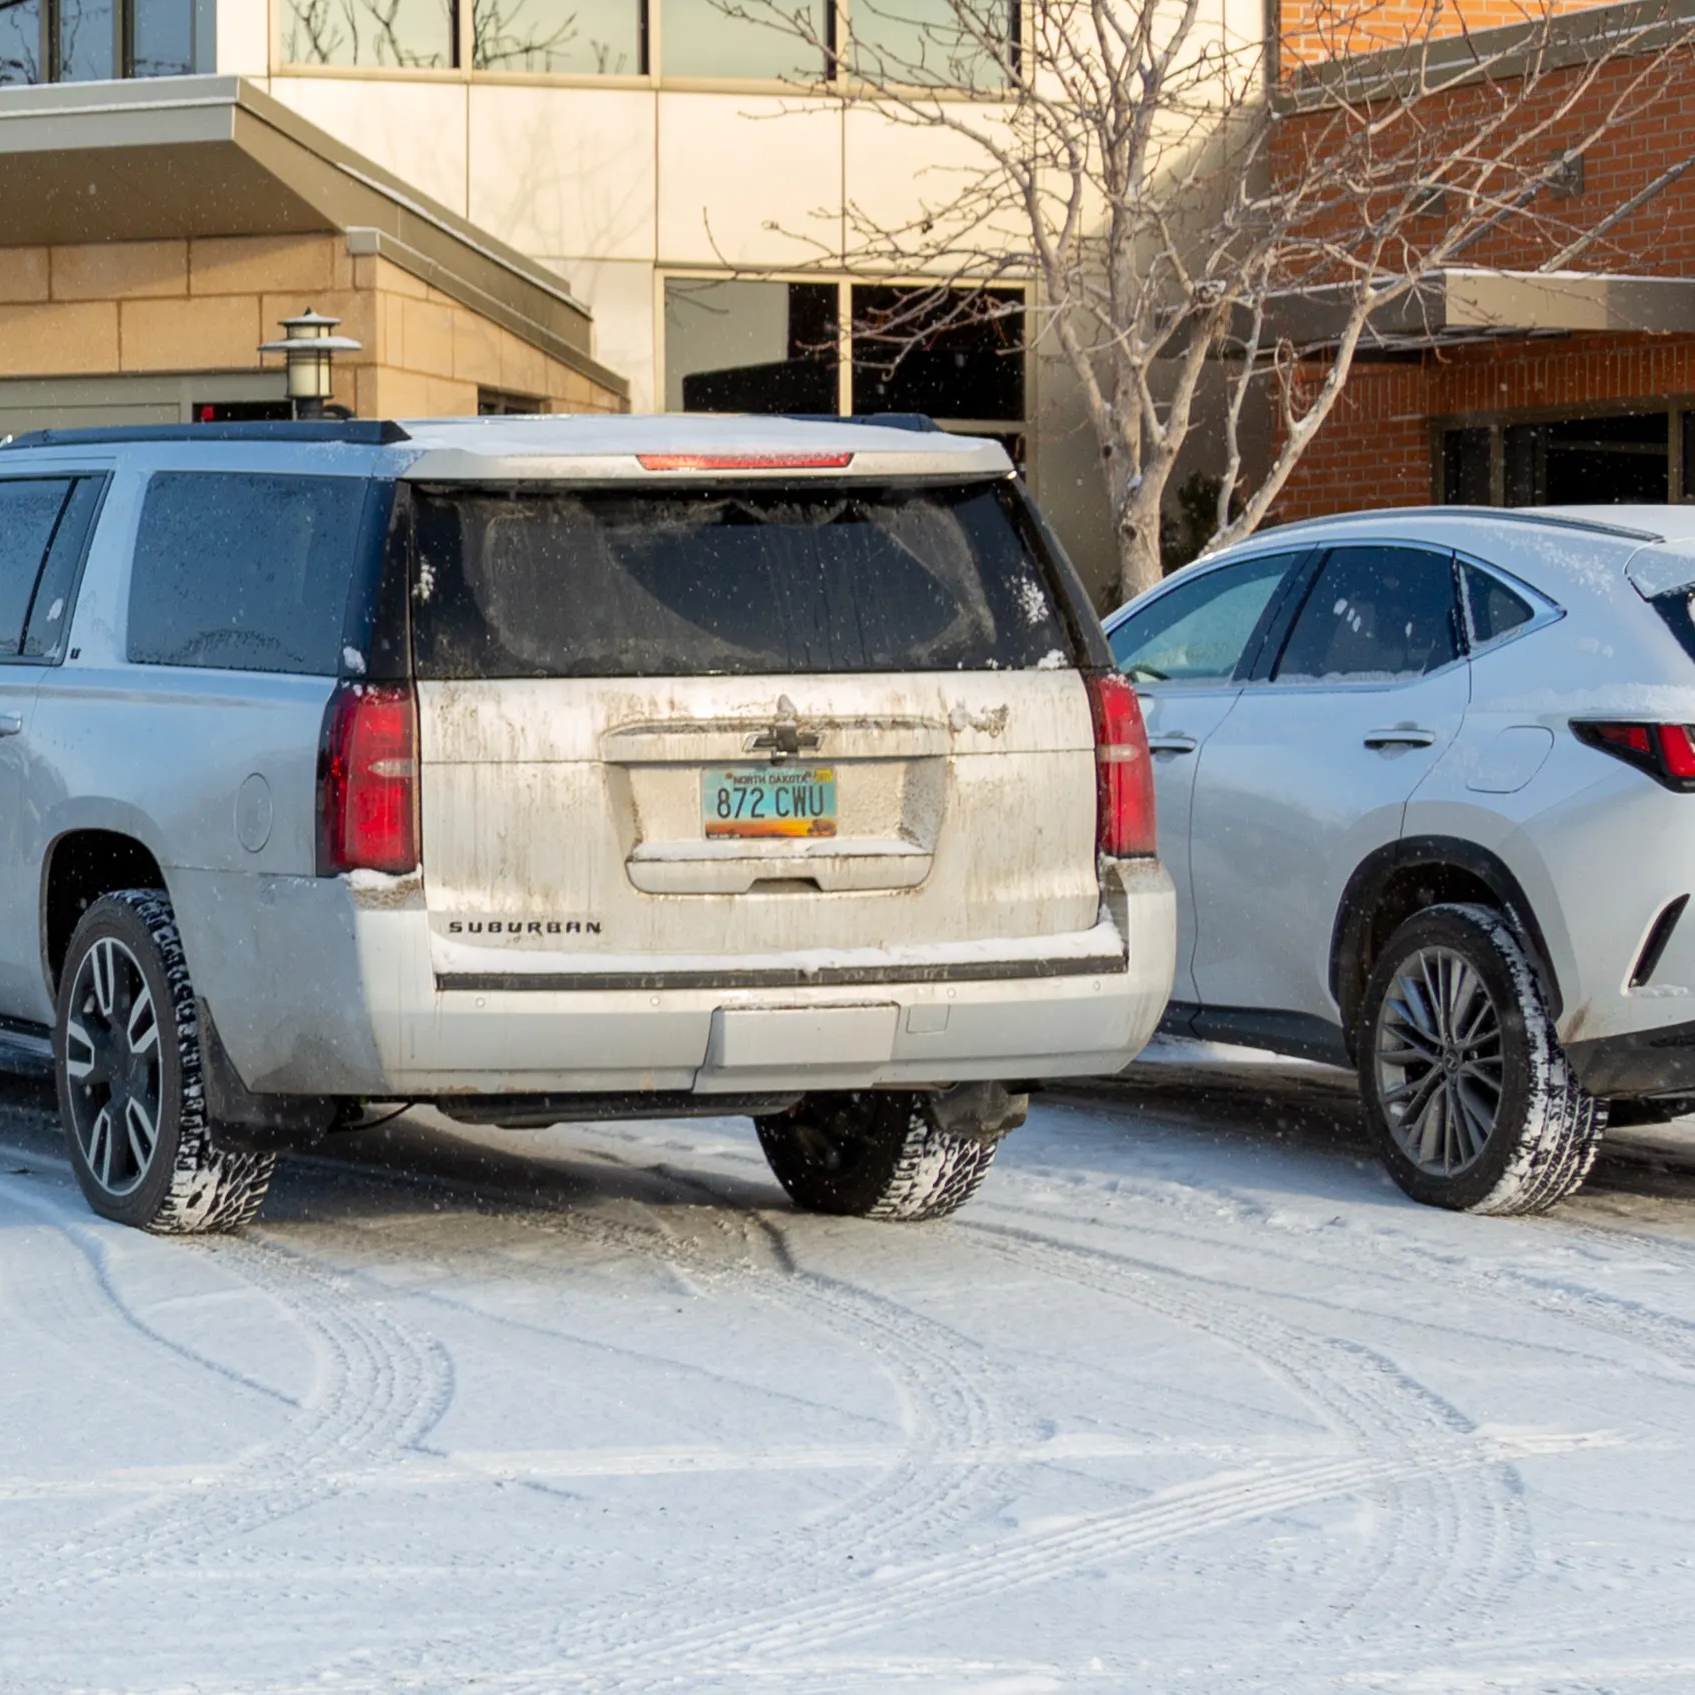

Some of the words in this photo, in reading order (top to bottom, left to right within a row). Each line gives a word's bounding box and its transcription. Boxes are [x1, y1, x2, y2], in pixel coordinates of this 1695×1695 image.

[732, 775, 766, 785] NORTH
[769, 773, 808, 785] DAKOTA
[716, 787, 766, 819] 872
[775, 785, 825, 818] CWU
[448, 921, 602, 936] SUBURBAN
